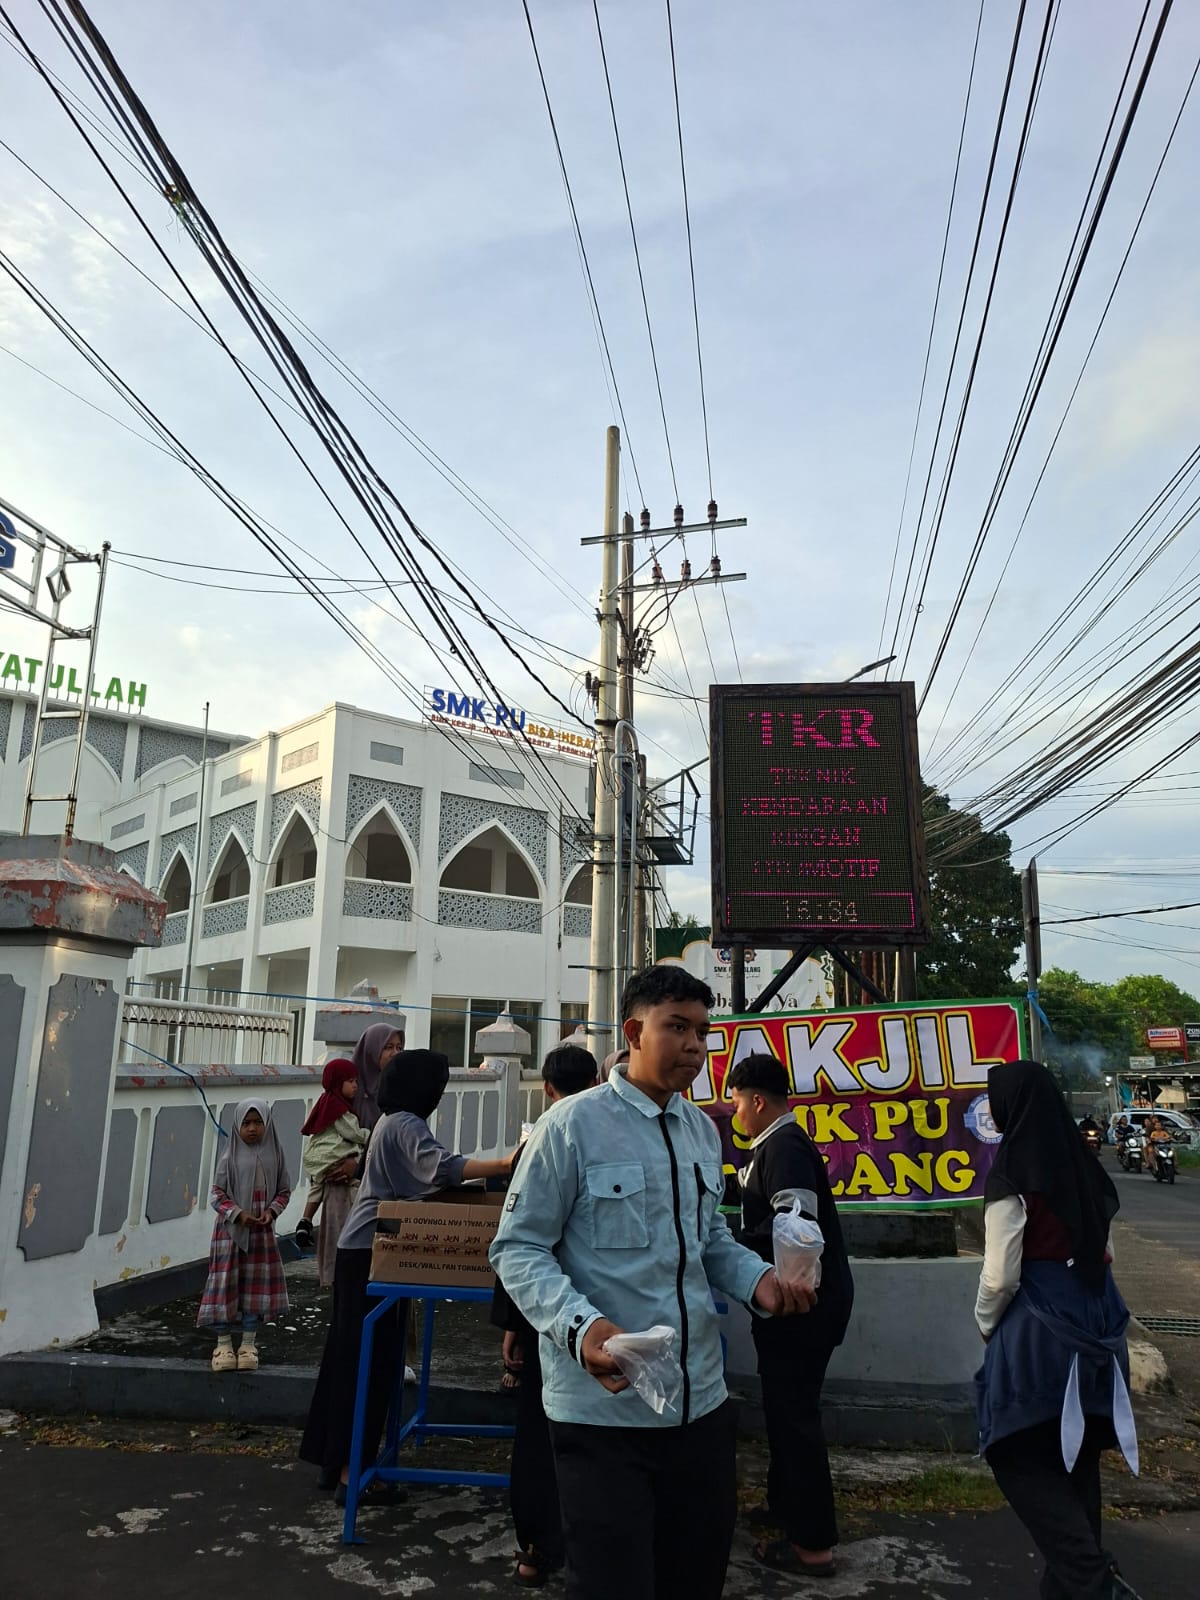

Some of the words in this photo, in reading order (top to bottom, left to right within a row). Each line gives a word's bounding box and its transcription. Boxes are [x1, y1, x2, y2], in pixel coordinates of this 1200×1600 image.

[0, 652, 147, 708] ATULLAH
[432, 688, 526, 731] SMK-PU
[748, 709, 880, 747] TKR
[741, 796, 888, 816] KENDARAAN
[690, 1014, 989, 1102] TAKJIL
[870, 1098, 950, 1139] PU
[413, 1217, 446, 1226] TORNADO
[399, 1261, 440, 1270] DESK/WALL
[442, 1263, 456, 1271] FAN
[458, 1264, 492, 1273] TORNADO
